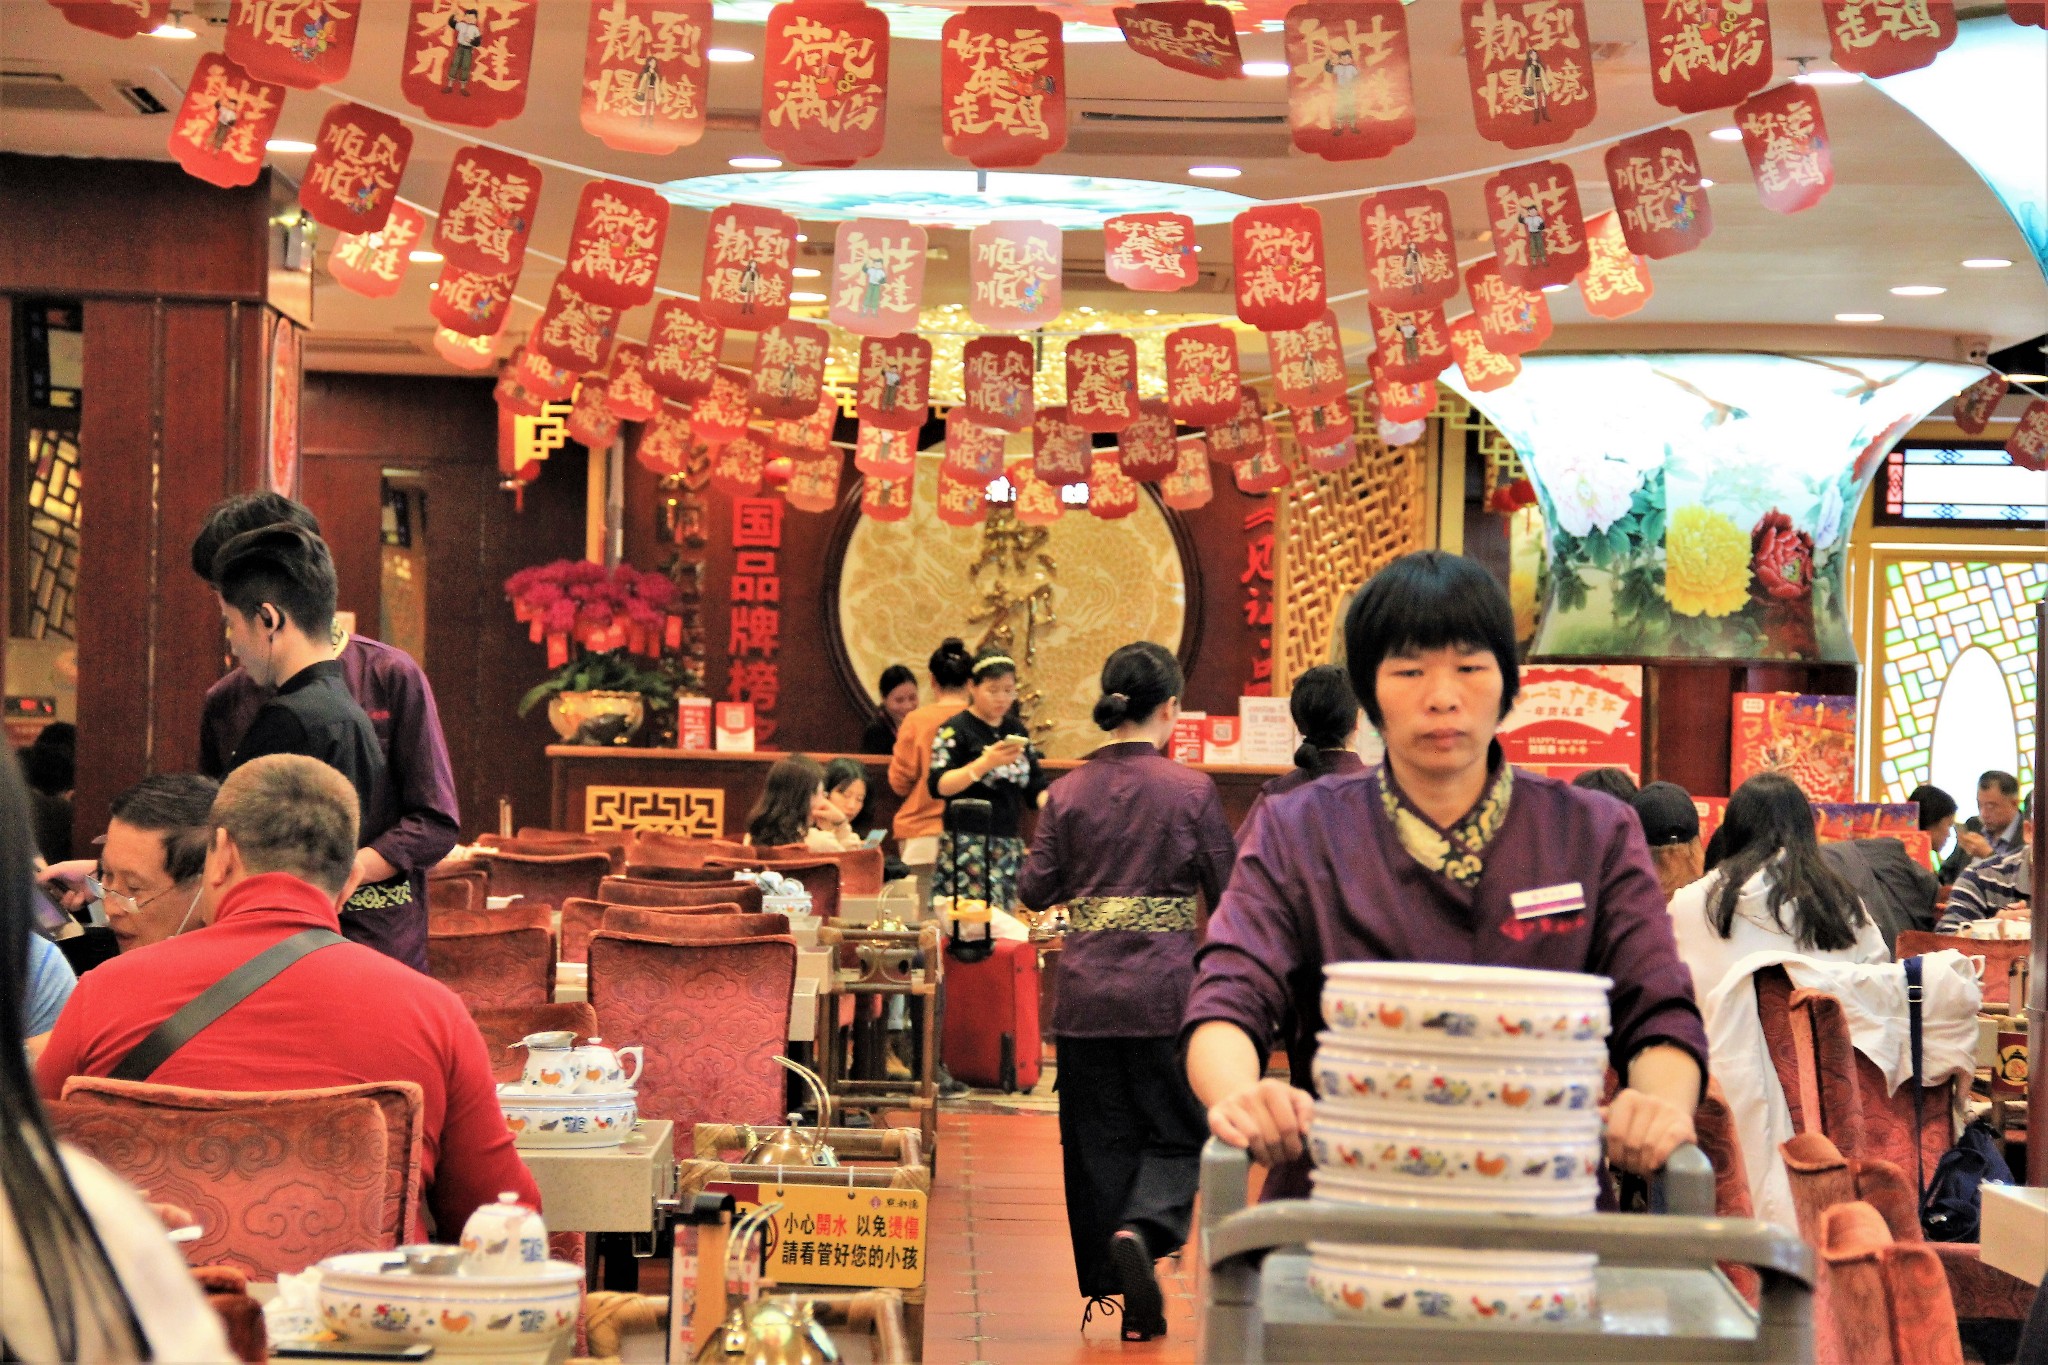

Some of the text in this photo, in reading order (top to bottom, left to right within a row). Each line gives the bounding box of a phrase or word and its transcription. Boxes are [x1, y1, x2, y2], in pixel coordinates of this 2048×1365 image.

[780, 16, 876, 79] 荷包
[947, 28, 1049, 75] 好运
[1658, 18, 1765, 84] 满泻
[768, 74, 882, 132] 满泻
[1741, 100, 1815, 139] 好运
[324, 122, 400, 172] 顺风
[1615, 146, 1696, 191] 顺风
[456, 159, 530, 213] 好运
[586, 192, 658, 250] 荷包
[1107, 220, 1185, 243] 好运
[1244, 221, 1314, 263] 荷包
[839, 231, 921, 287] 身壮
[977, 235, 1057, 271] 顺风
[976, 265, 1057, 308] 顺水
[1241, 264, 1322, 307] 满泻
[784, 1212, 920, 1240] 小心開水 以免燙傷
[781, 1240, 919, 1270] 請看管好您的小孩
